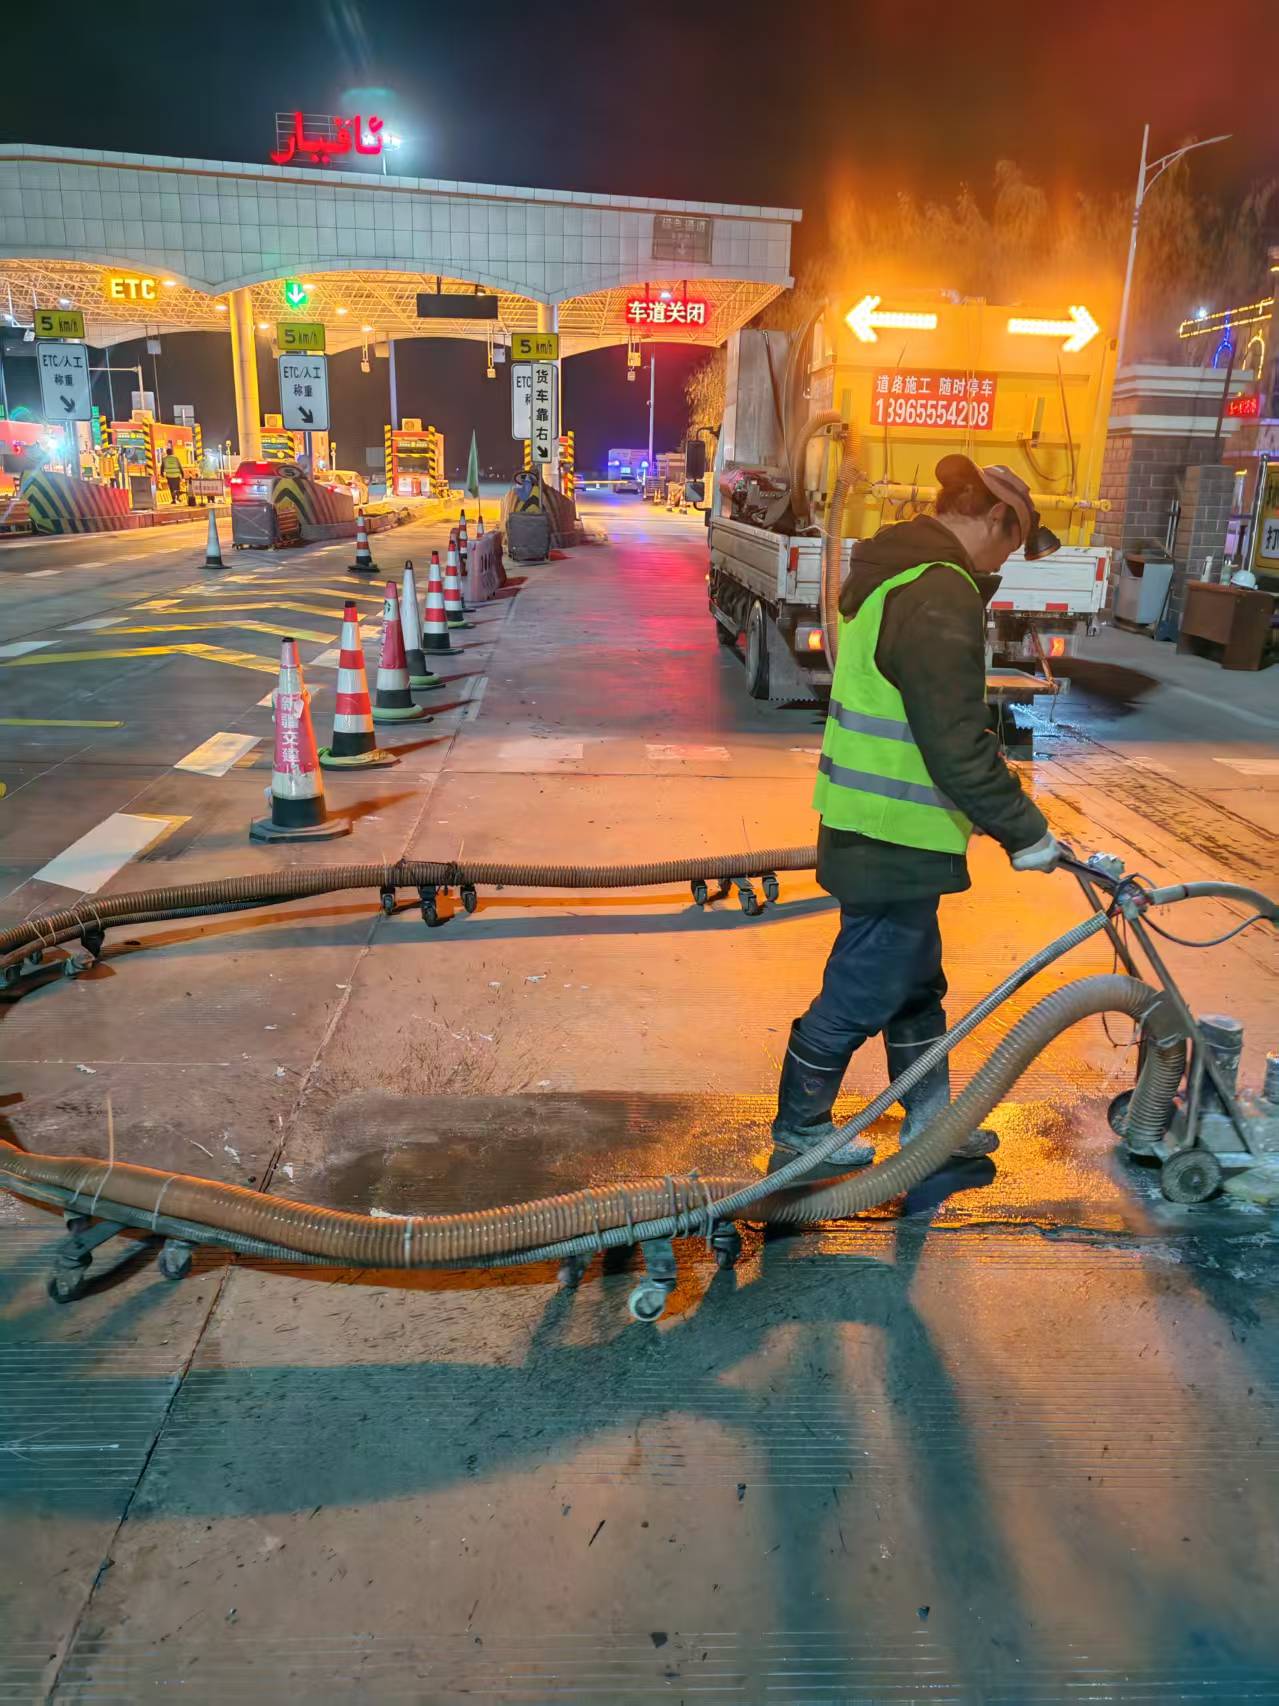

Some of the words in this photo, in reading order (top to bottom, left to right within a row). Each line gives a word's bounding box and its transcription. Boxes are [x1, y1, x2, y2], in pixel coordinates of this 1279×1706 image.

[110, 278, 157, 299] ETC
[628, 301, 705, 324] 车道关闭
[41, 316, 53, 331] 5
[59, 319, 79, 333] km/h
[285, 329, 296, 344] 5
[299, 331, 317, 345] km/h
[520, 339, 532, 354] 5
[535, 340, 553, 355] km/h
[42, 354, 83, 369] ETC/人工
[54, 373, 75, 387] 称重
[283, 366, 322, 379] ETC/人工
[293, 384, 312, 397] 称重
[877, 375, 931, 394] 道路施工
[938, 377, 993, 397] 随时停车
[535, 369, 549, 441] 货车靠右
[876, 398, 990, 426] 13965554208
